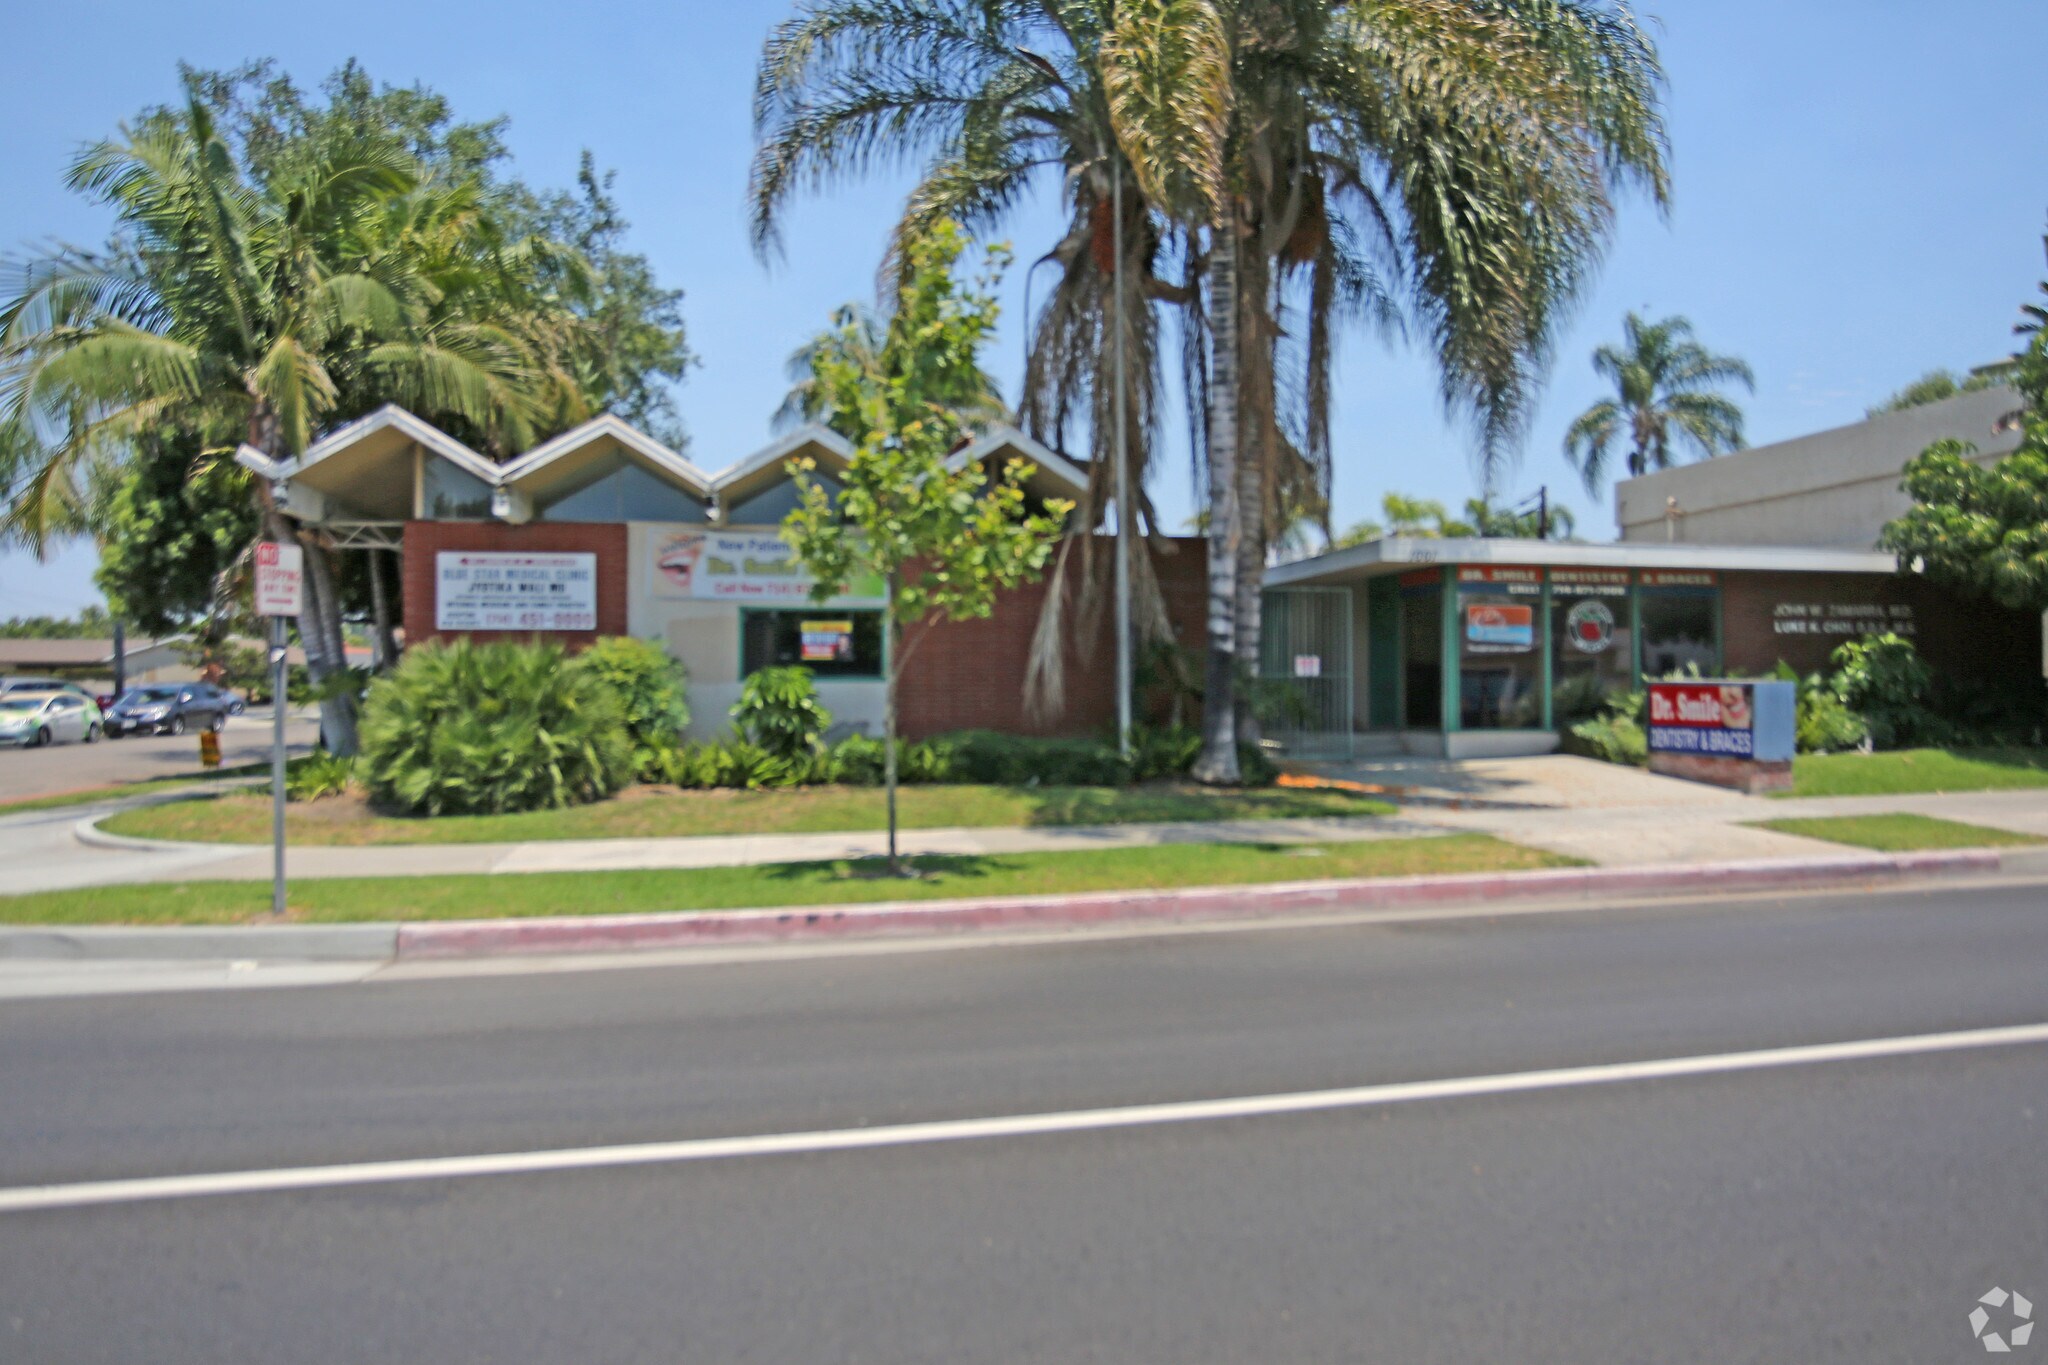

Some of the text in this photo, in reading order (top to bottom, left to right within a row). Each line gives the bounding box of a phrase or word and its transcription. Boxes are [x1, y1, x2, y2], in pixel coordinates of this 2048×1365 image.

[718, 539, 744, 551] New
[474, 569, 500, 580] STAR
[505, 569, 550, 580] MEDICAL
[555, 569, 589, 580] CLINIC
[1491, 569, 1537, 582] SMILE
[1550, 571, 1630, 584] DENTISTRY
[1657, 574, 1712, 587] BRACES
[714, 582, 738, 594] Call
[740, 583, 764, 594] Now
[1774, 604, 1807, 617] JOHN
[1774, 620, 1807, 633] LUKE
[1651, 692, 1721, 721] Dr. Smile
[1650, 727, 1752, 754] DENTISTRY & BRACES
